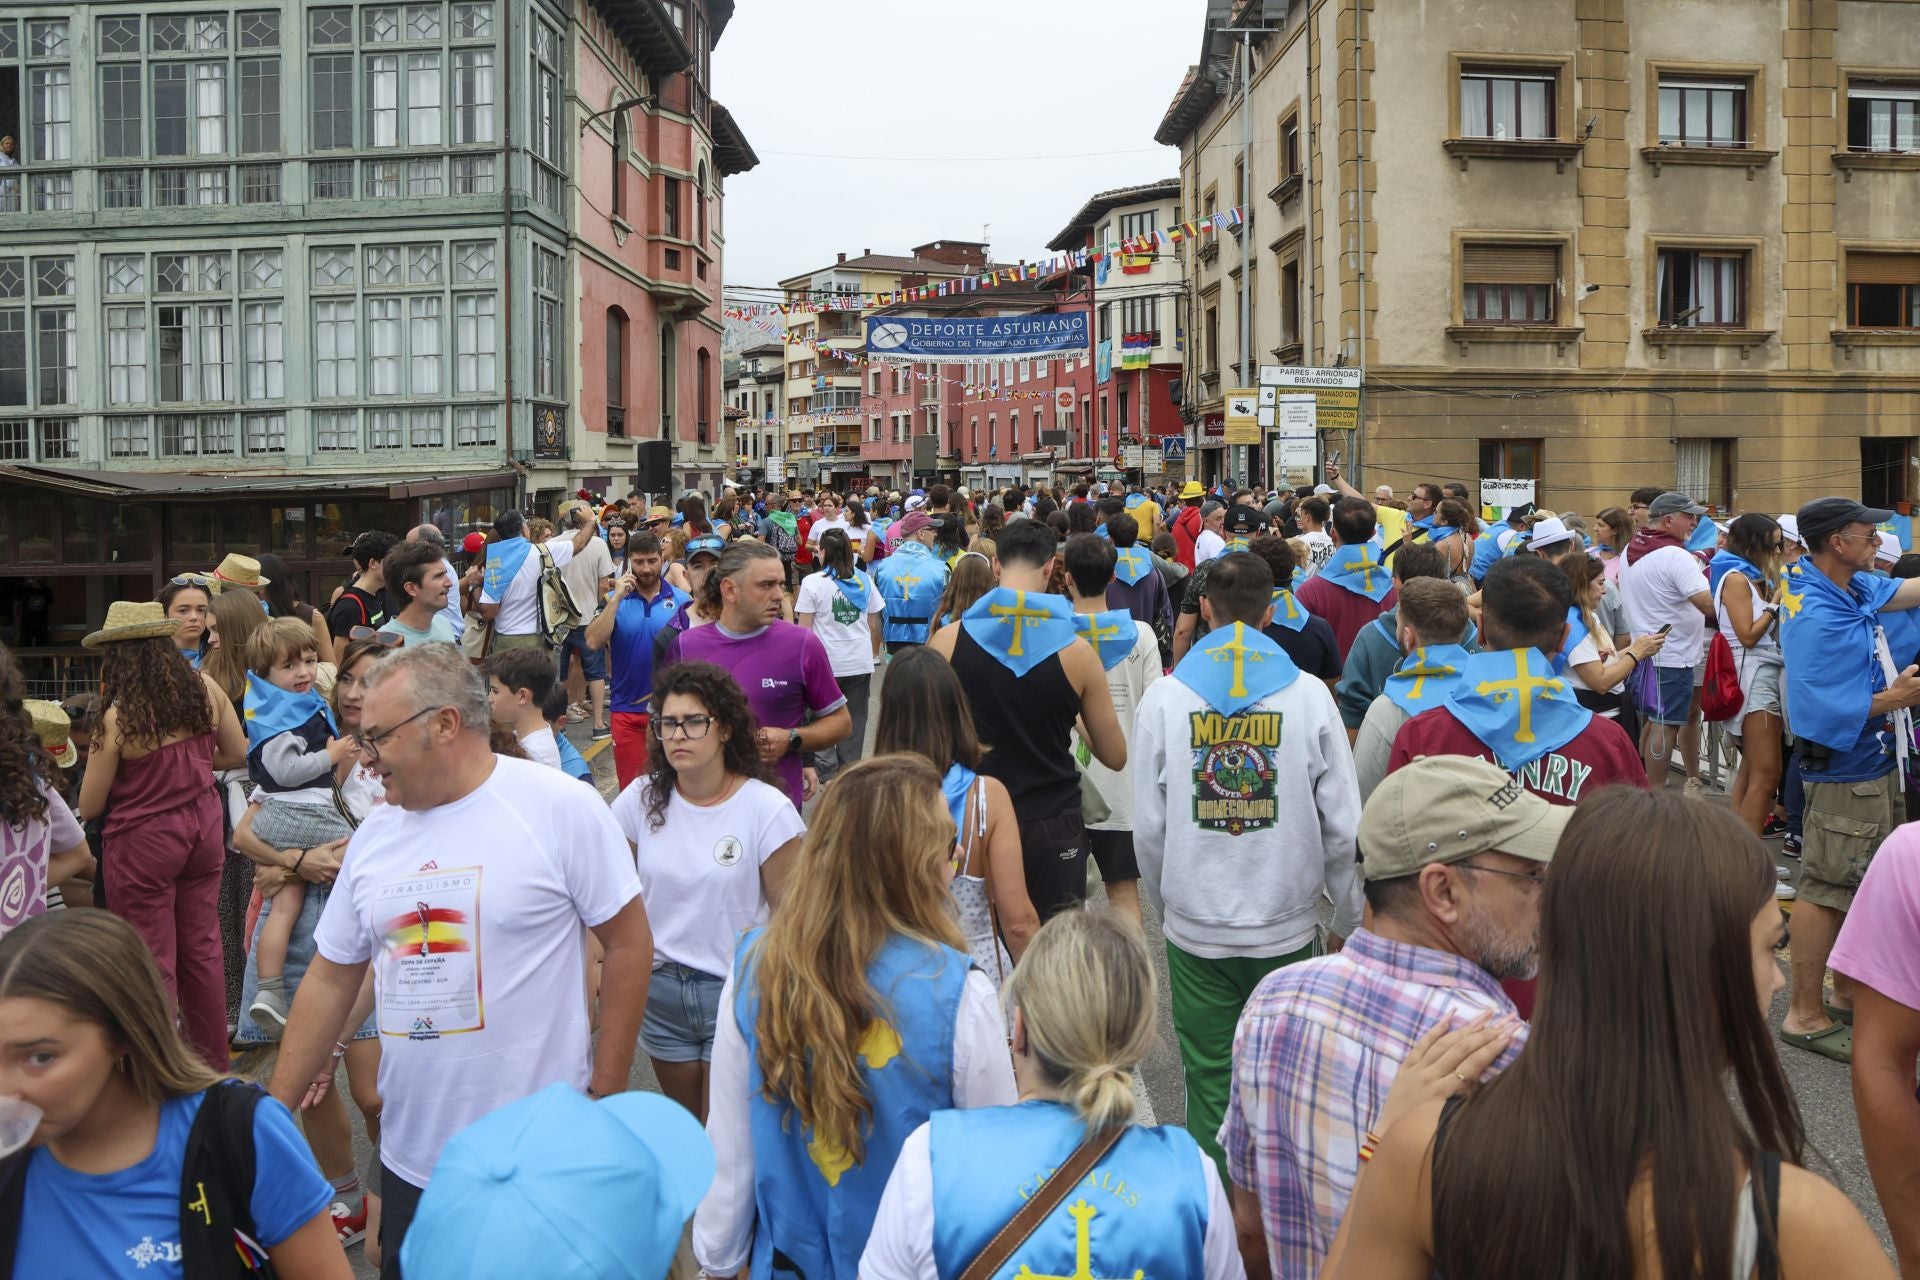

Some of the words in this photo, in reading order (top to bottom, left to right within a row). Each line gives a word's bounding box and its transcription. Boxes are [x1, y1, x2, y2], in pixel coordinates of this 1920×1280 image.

[912, 324, 984, 336] DEPORTE
[992, 317, 1083, 335] ASTURIANO
[1030, 353, 1056, 361] AGOSTO
[1280, 368, 1310, 376] PARRES
[1316, 370, 1359, 378] ARRIONDAS
[1294, 376, 1344, 385] BIENVENIDOS
[1343, 411, 1355, 419] CON
[1191, 711, 1282, 747] MIZZOU
[1197, 799, 1275, 820] HOMECOMING
[382, 878, 472, 896] PIRAGÜISMO
[424, 957, 446, 965] ESPAÑA
